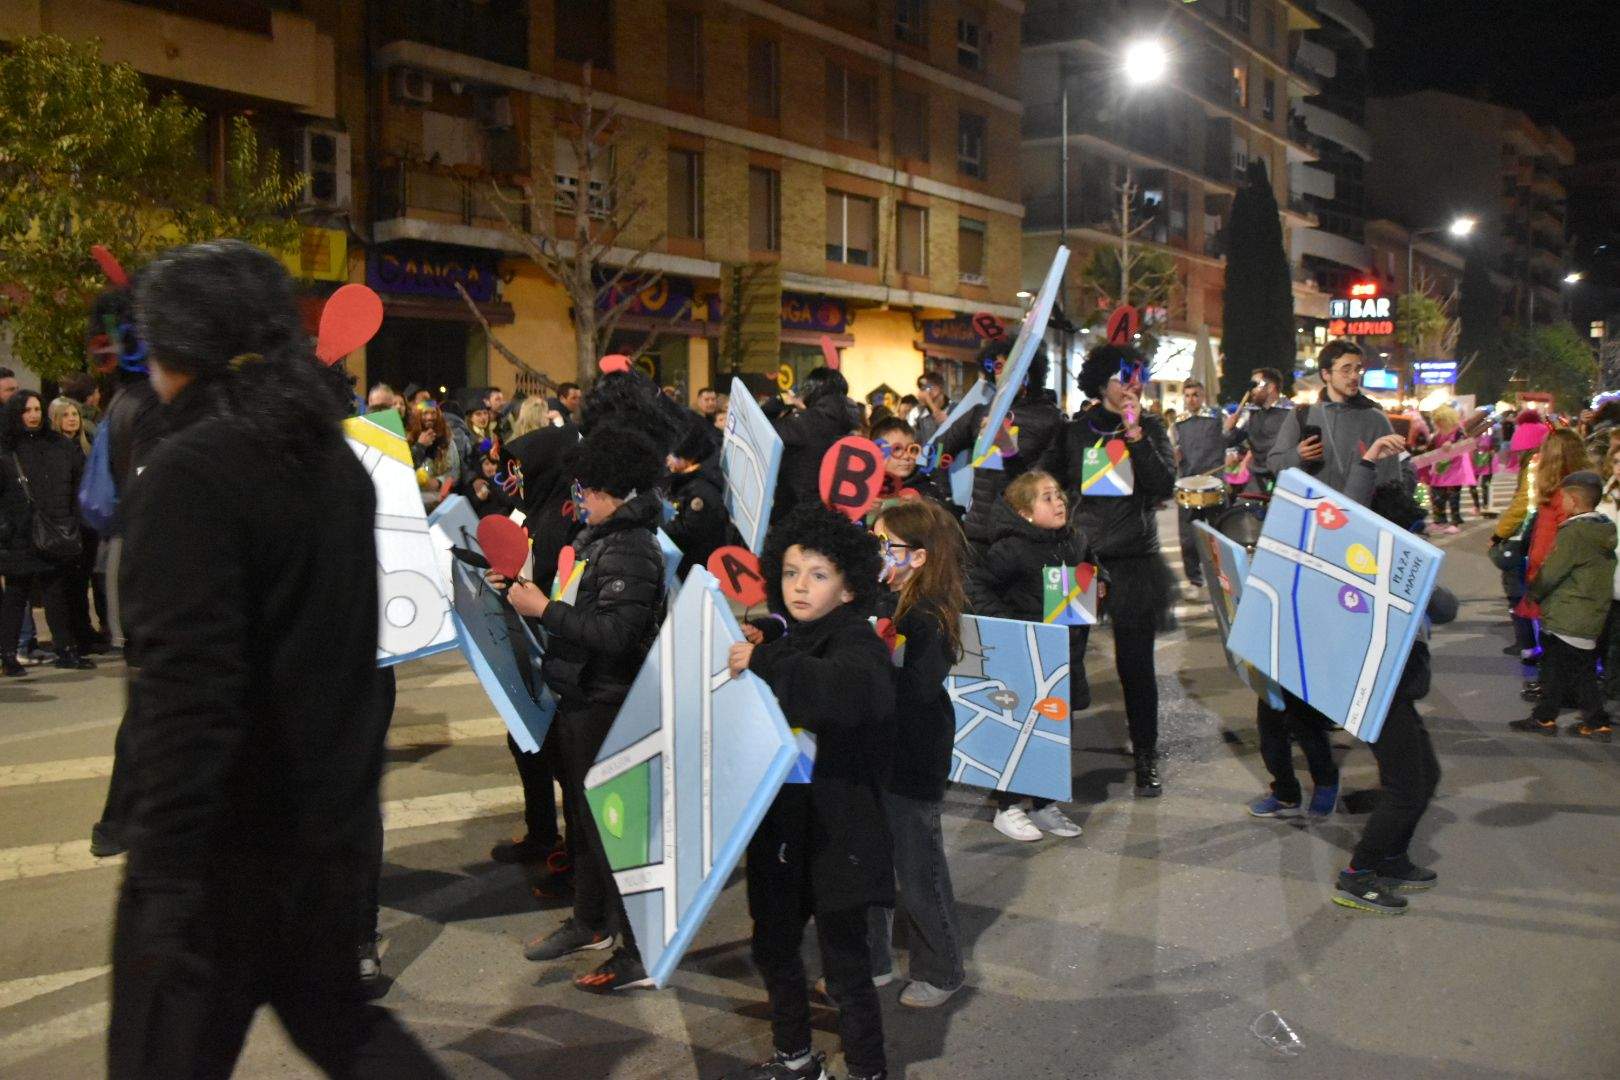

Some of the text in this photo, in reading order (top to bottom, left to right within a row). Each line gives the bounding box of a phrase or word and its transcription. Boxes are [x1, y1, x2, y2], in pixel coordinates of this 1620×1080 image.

[1350, 298, 1390, 318] BAR
[976, 316, 1004, 340] B
[1110, 312, 1130, 343] A
[829, 444, 876, 508] B
[721, 554, 761, 594] A
[1392, 551, 1411, 584] PLAZA
